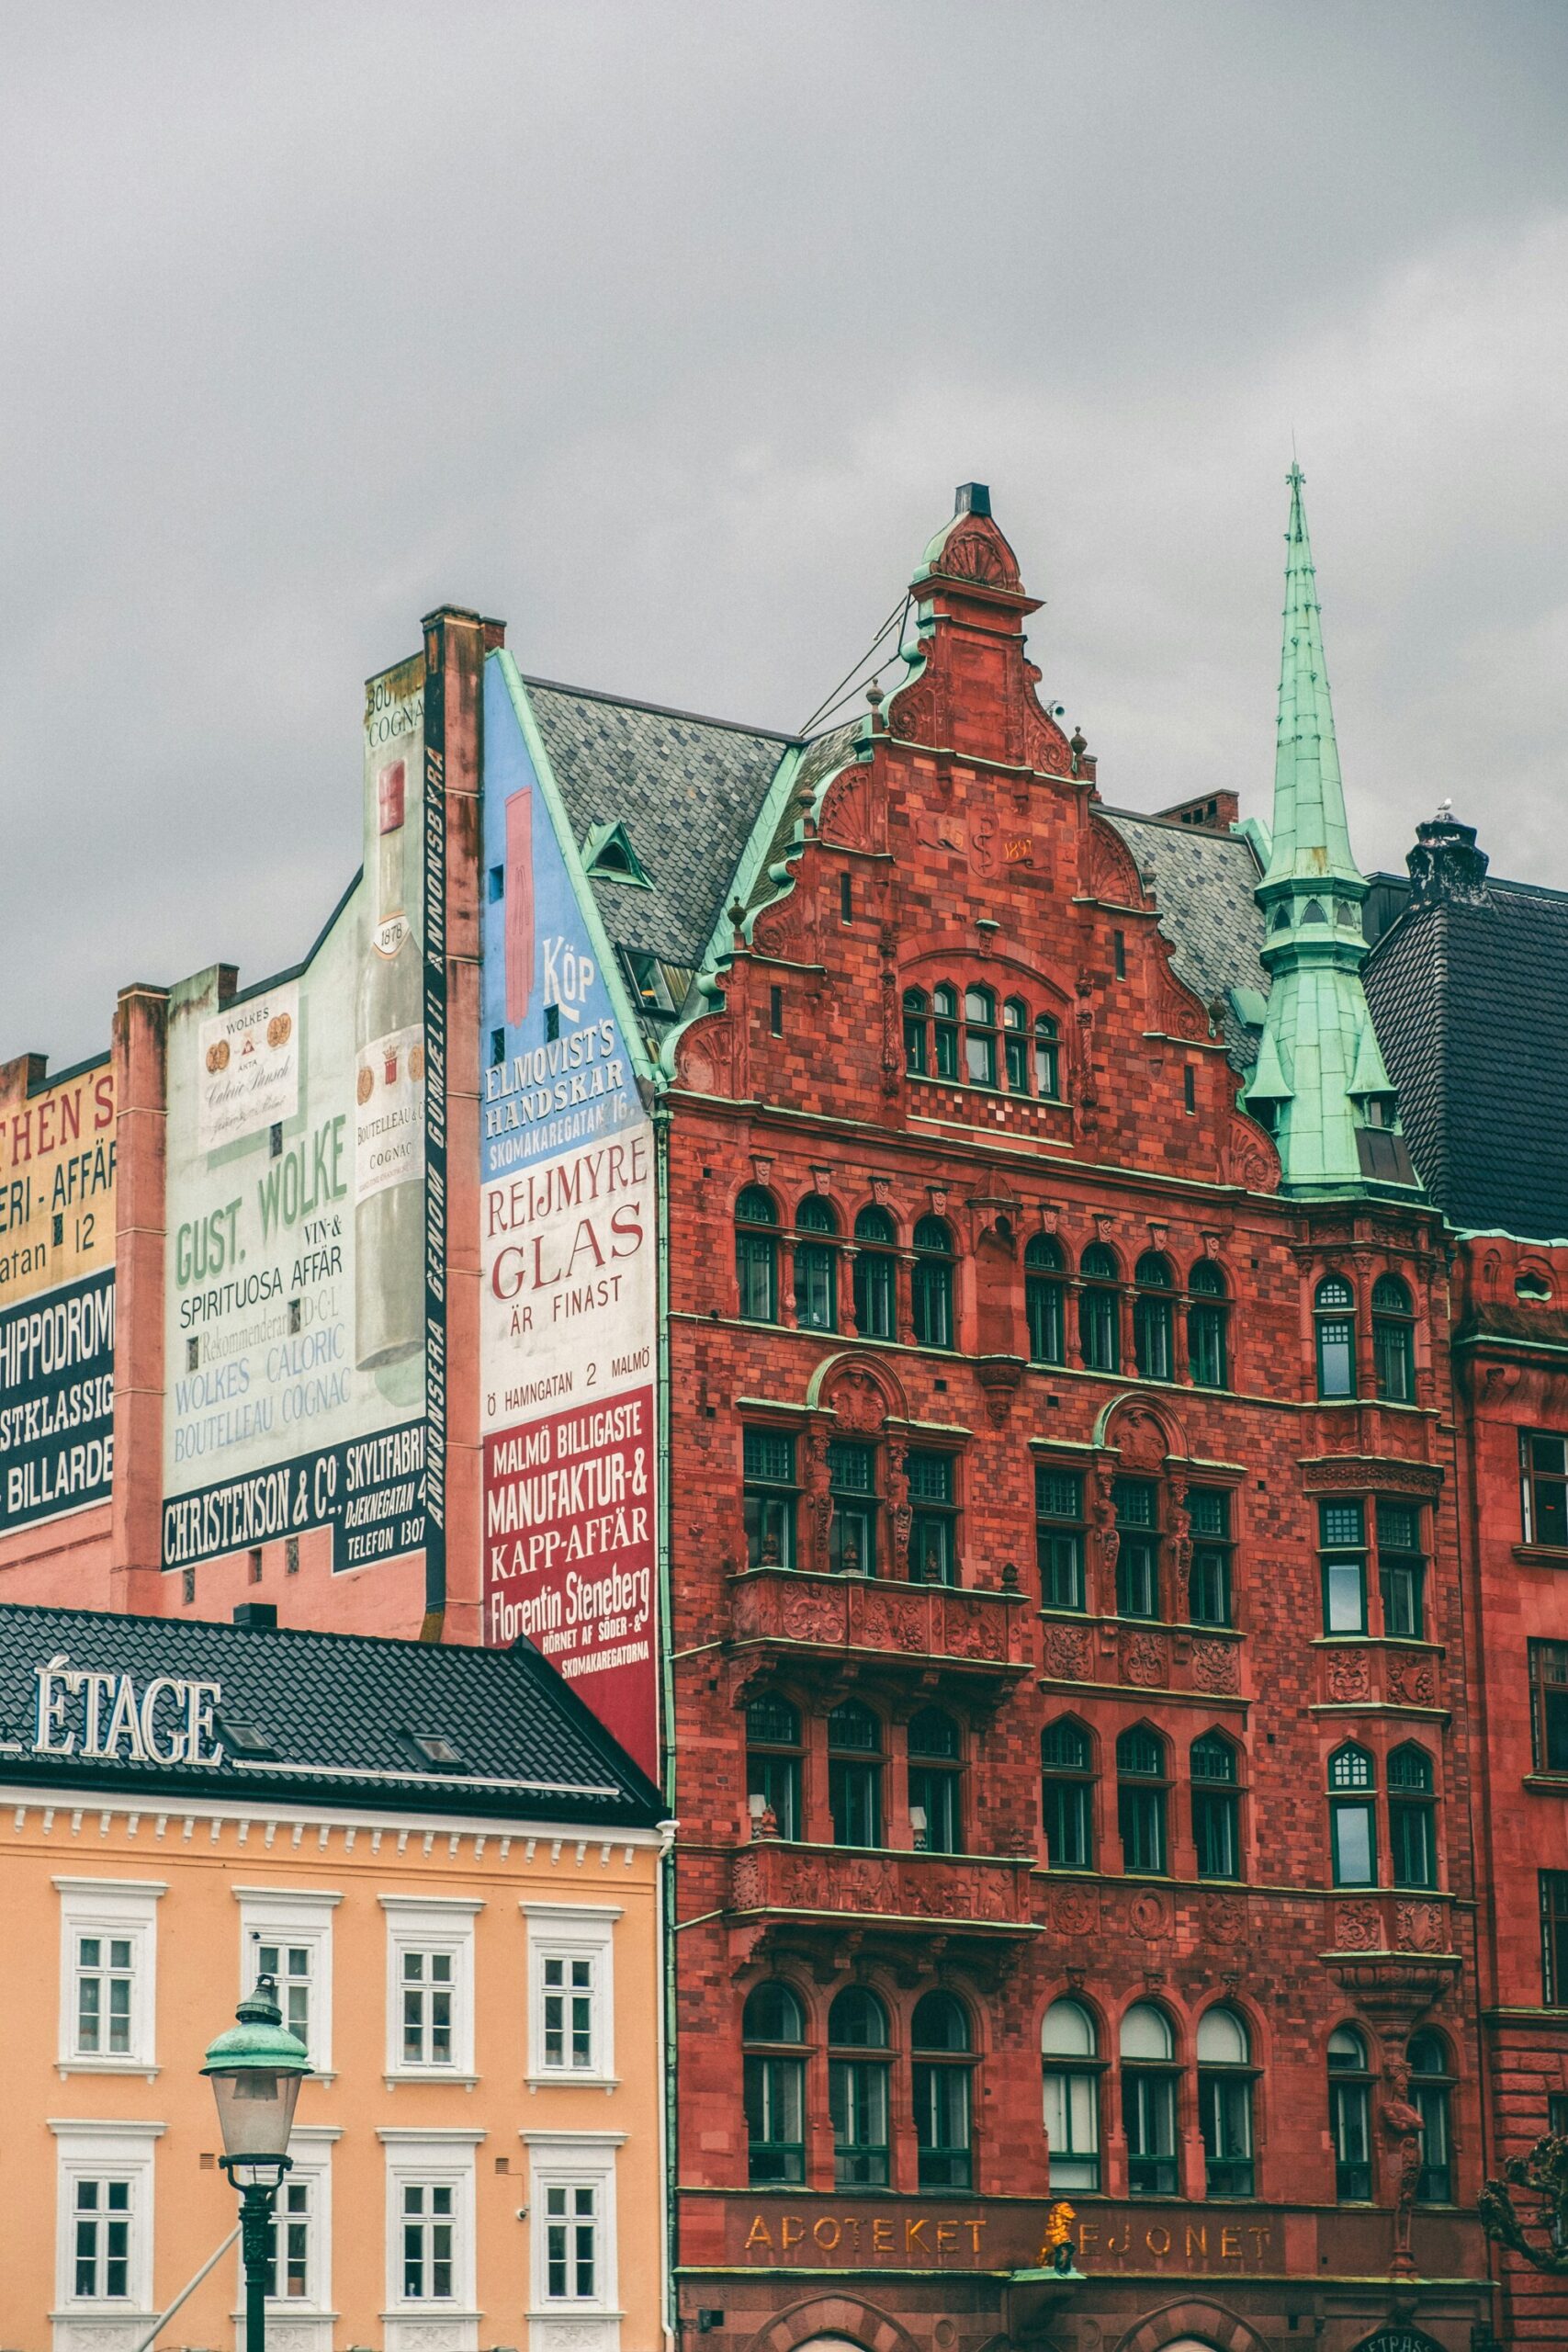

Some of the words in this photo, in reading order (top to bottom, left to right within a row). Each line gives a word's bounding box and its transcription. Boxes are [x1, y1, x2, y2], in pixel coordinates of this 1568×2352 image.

[380, 922, 402, 946] 1878
[543, 935, 594, 1023] KÖP
[225, 1007, 270, 1035] WOLKES
[485, 1018, 615, 1104] ELMQVIST'S
[486, 1059, 625, 1140] HANDSKAR
[357, 1107, 412, 1147] BOUTELLEAU
[369, 1142, 412, 1170] COGNAC
[490, 1103, 605, 1171] SKOMAKAREGATAN
[176, 1196, 245, 1288] GUST.
[257, 1114, 347, 1244] WOLKE
[487, 1136, 648, 1238] REIJMYRE
[0, 1242, 46, 1284] atan
[76, 1213, 95, 1253] 12
[427, 1161, 445, 1303] GENOM
[492, 1201, 644, 1300] GLAS
[180, 1267, 284, 1329] SPIRITUOSA
[291, 1245, 343, 1290] AFFÄR
[511, 1305, 533, 1337] ÄR
[554, 1275, 623, 1322] FINAST
[0, 1283, 116, 1390] HIPPODROM
[175, 1357, 250, 1416] WOLKES
[266, 1323, 345, 1383] CALORIC
[202, 1308, 288, 1364] Rekommenderar
[175, 1396, 274, 1464] BOUTELLEAU
[282, 1367, 351, 1423] COGNAC
[505, 1371, 572, 1411] HAMNGATAN
[586, 1363, 597, 1386] 2
[612, 1347, 650, 1379] MALMÖ
[346, 1425, 426, 1492] SKYLTFABRI
[427, 1317, 444, 1529] ANNONSERA
[493, 1425, 550, 1478] MALMÖ
[558, 1400, 642, 1459] BILLIGASTE
[164, 1468, 290, 1565] CHRISTENSON
[292, 1470, 309, 1526] &
[417, 1473, 426, 1507] 4
[347, 1526, 394, 1561] TELEFON
[400, 1516, 426, 1546] 1307
[491, 1506, 649, 1582] KAPP-AFFÄR
[491, 1585, 562, 1644] Florentin
[566, 1562, 650, 1623] Steneberg
[542, 1630, 578, 1655] HÖRNET
[581, 1625, 592, 1645] AF
[561, 1640, 649, 1679] SKOMAKAREGATORNA
[32, 1655, 223, 1767] ÉTAGE
[745, 2215, 987, 2255] APOTEKET
[1078, 2222, 1272, 2259] EJONET
